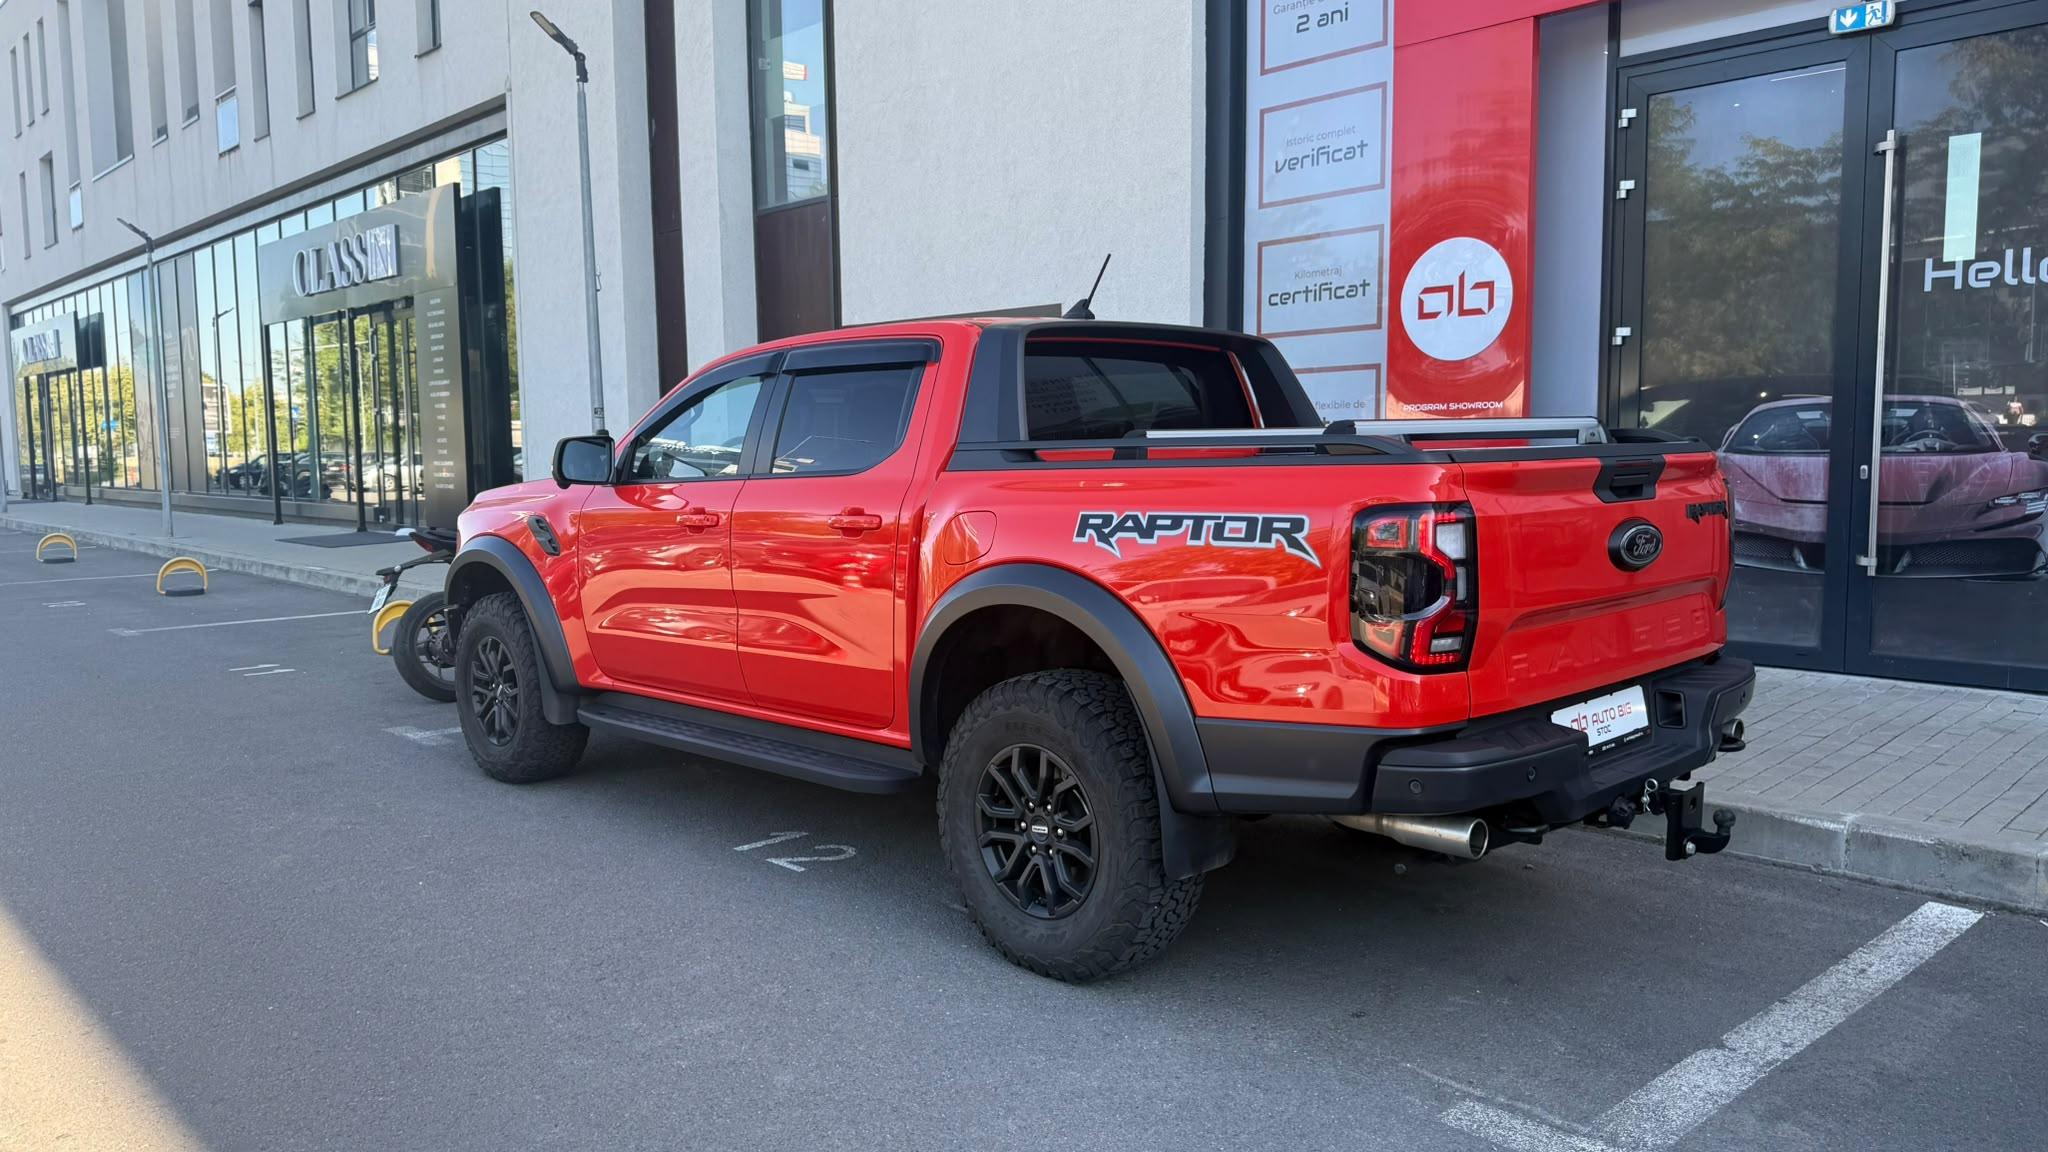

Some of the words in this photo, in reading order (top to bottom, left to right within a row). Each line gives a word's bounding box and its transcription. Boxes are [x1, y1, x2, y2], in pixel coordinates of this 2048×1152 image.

[1296, 14, 1310, 33] 2
[1317, 2, 1349, 27] ani
[1286, 132, 1314, 147] Istoric
[1316, 124, 1356, 146] complet
[1274, 139, 1369, 174] verificat
[1294, 264, 1343, 280] Kilometraj
[1923, 247, 2048, 292] Hell
[1268, 279, 1371, 306] certificat
[1353, 399, 1366, 409] de
[1403, 403, 1447, 412] PROGRAM
[1449, 401, 1504, 410] SHOWROOM
[1072, 510, 1323, 569] RAPTOR
[1633, 533, 1657, 556] Ford
[1591, 707, 1616, 726] AUTO
[1617, 702, 1632, 717] BIG
[1596, 724, 1612, 737] STOC
[733, 831, 857, 872] 12
